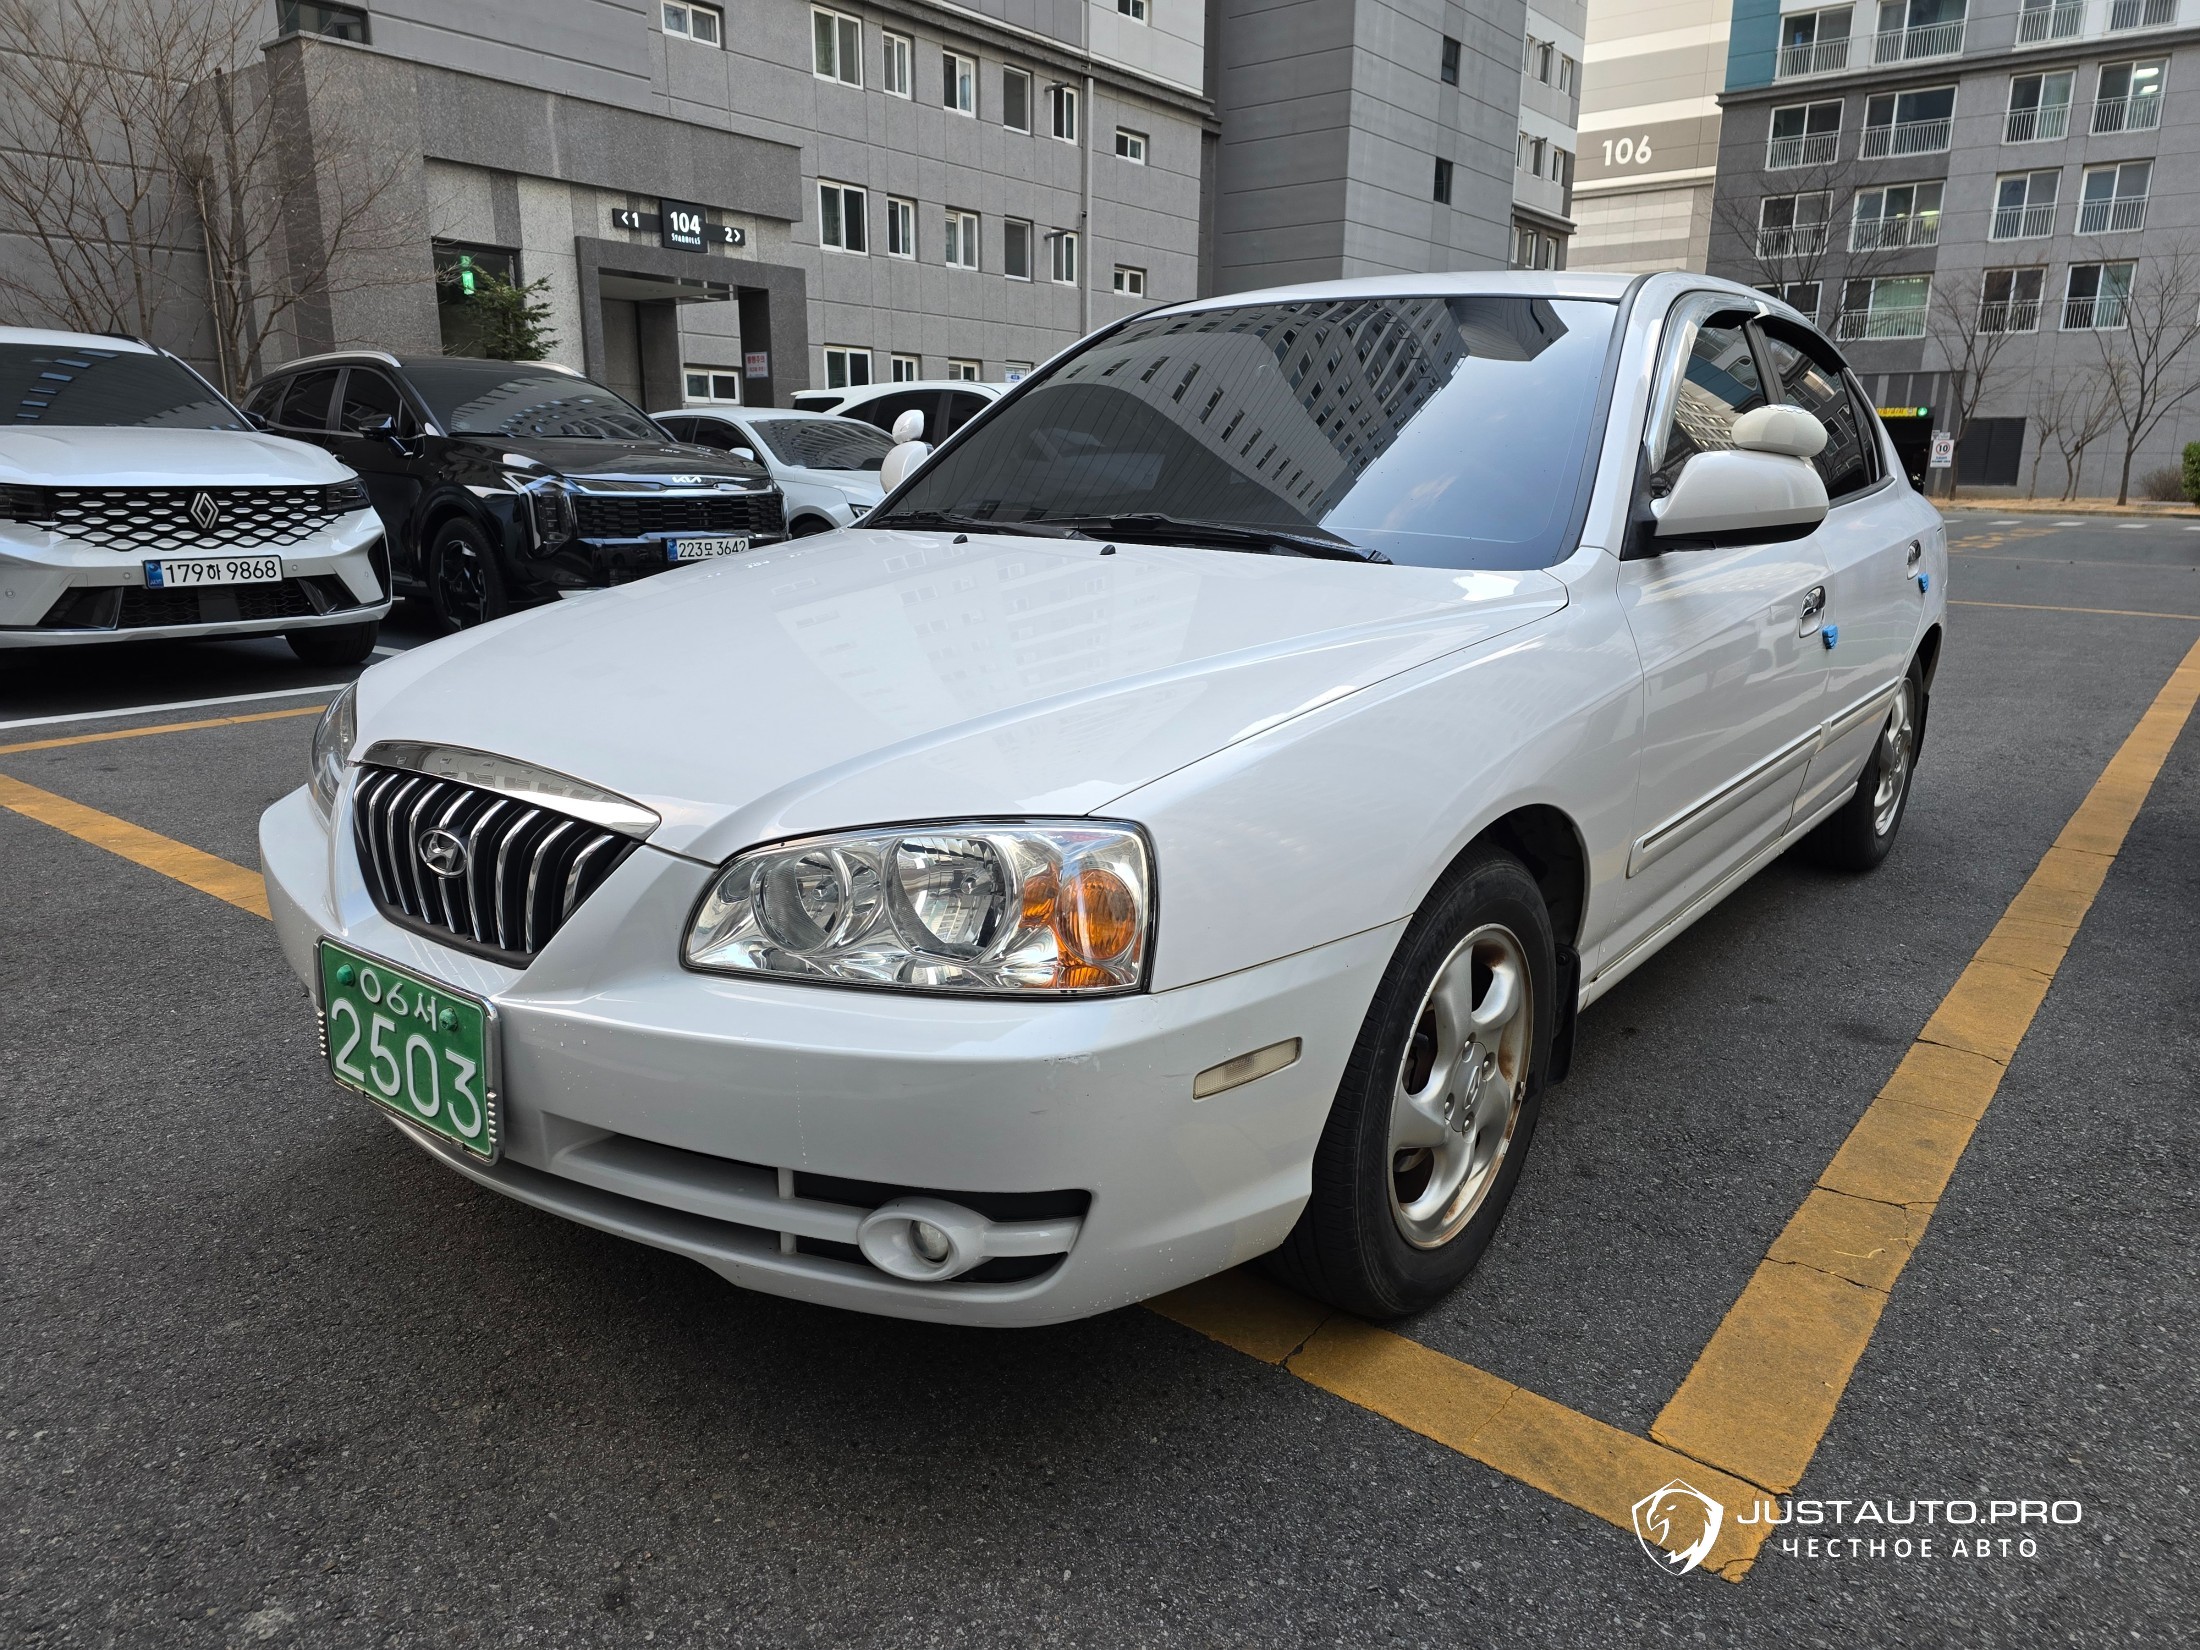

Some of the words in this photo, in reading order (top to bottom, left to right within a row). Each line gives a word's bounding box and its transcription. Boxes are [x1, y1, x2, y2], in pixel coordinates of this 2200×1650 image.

[1602, 134, 1652, 167] 106
[670, 211, 701, 234] 104
[678, 542, 713, 557] 223모
[165, 563, 221, 583] 179하
[227, 560, 277, 580] 9868
[359, 967, 437, 1032] 06서
[331, 997, 482, 1138] 2503
